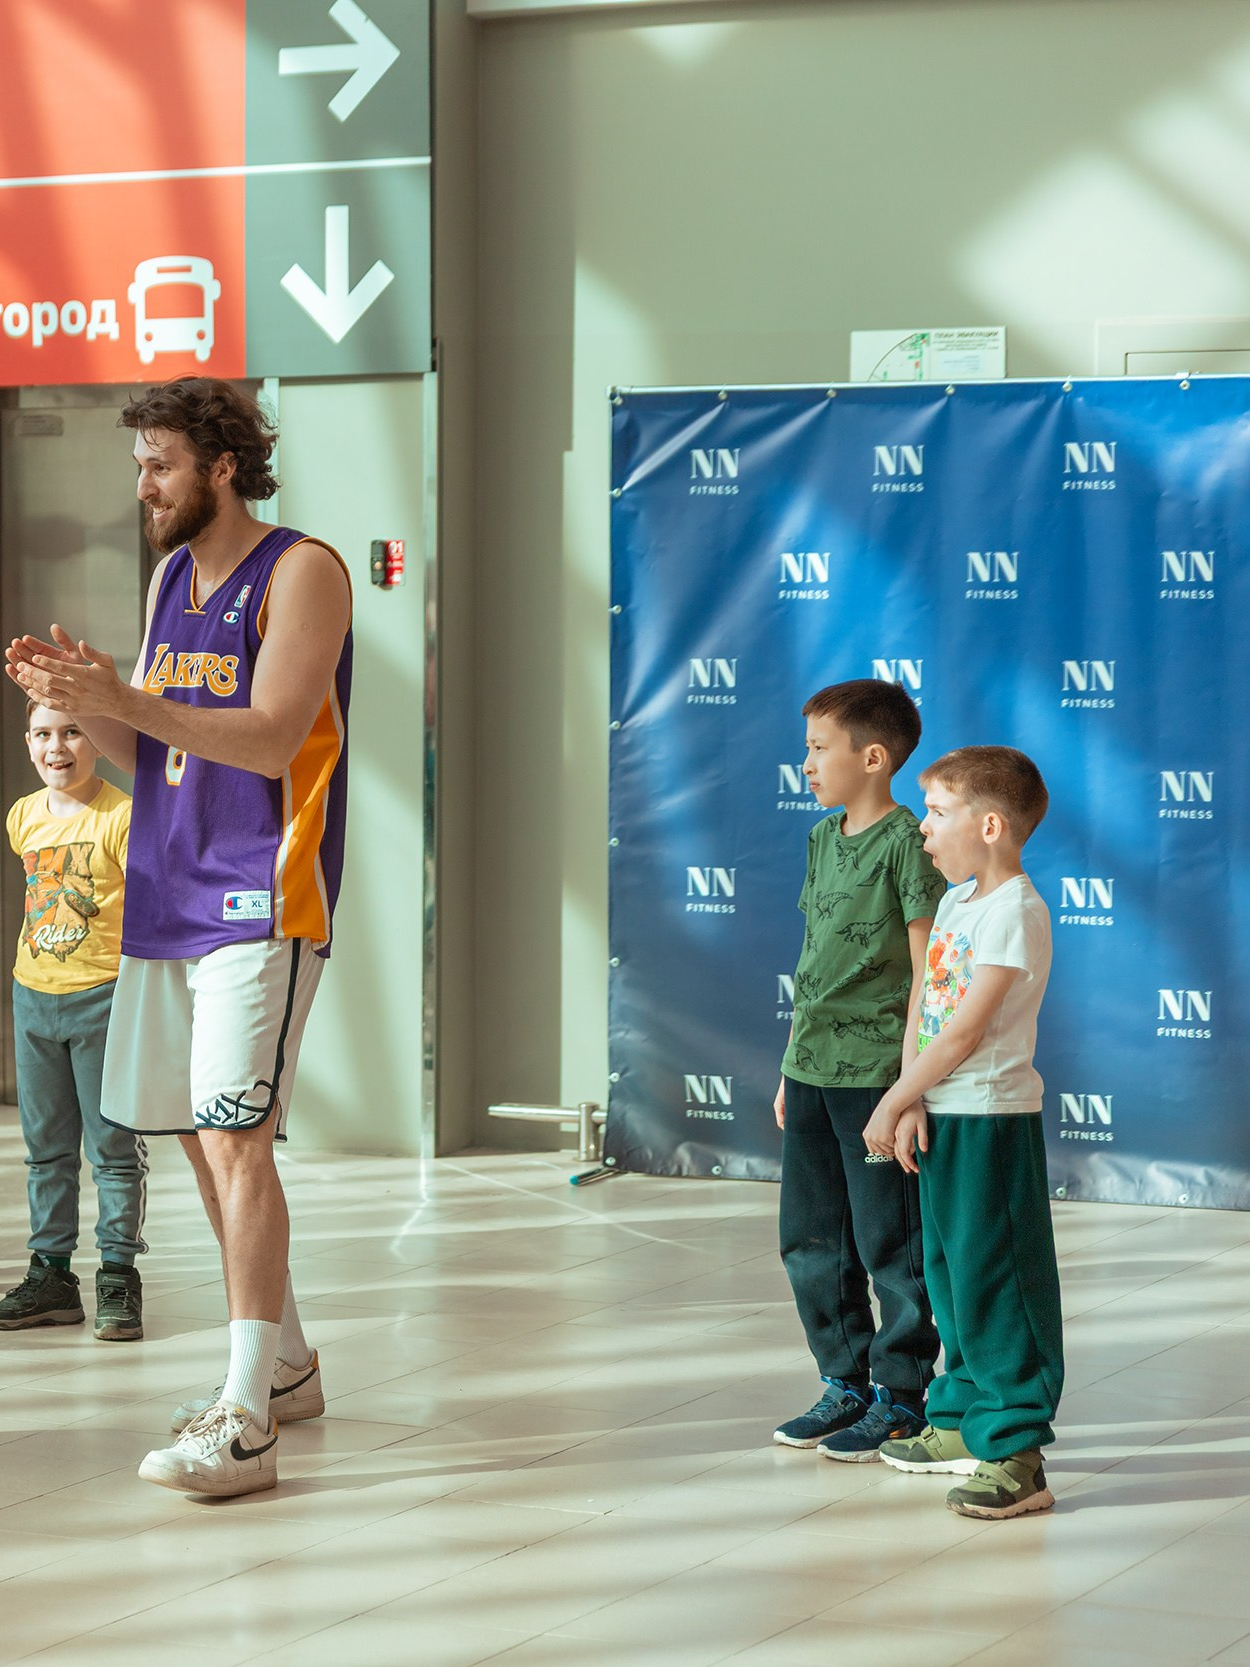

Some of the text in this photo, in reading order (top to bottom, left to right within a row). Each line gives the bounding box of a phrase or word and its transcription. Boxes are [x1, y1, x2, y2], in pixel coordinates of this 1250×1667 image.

[690, 448, 740, 479] NN
[872, 444, 925, 476] NN
[1063, 441, 1117, 473] NN
[689, 485, 740, 495] FITNESS
[872, 482, 925, 493] FITNESS
[1062, 480, 1117, 491] FITNESS
[779, 552, 830, 583] NN
[965, 552, 1019, 582] NN
[1161, 551, 1215, 582] NN
[778, 589, 830, 600] FITNESS
[965, 589, 1018, 600] FITNESS
[1160, 589, 1214, 600] FITNESS
[688, 658, 738, 688] NN
[1061, 660, 1116, 691] NN
[687, 694, 737, 705] FITNESS
[1061, 698, 1115, 708] FITNESS
[777, 764, 814, 794] N
[1159, 770, 1214, 802] NN
[1158, 809, 1213, 819] FITNESS
[686, 866, 737, 897] NN
[1060, 877, 1115, 909] NN
[251, 900, 263, 908] XL
[686, 903, 736, 913] FITNESS
[1059, 915, 1114, 926] FITNESS
[33, 923, 87, 950] Rider
[1157, 989, 1213, 1021] NN
[1157, 1027, 1212, 1039] FITNESS
[683, 1075, 733, 1105] NN
[686, 1110, 735, 1121] FITNESS
[1059, 1093, 1114, 1125] NN
[1059, 1130, 1114, 1141] FITNESS
